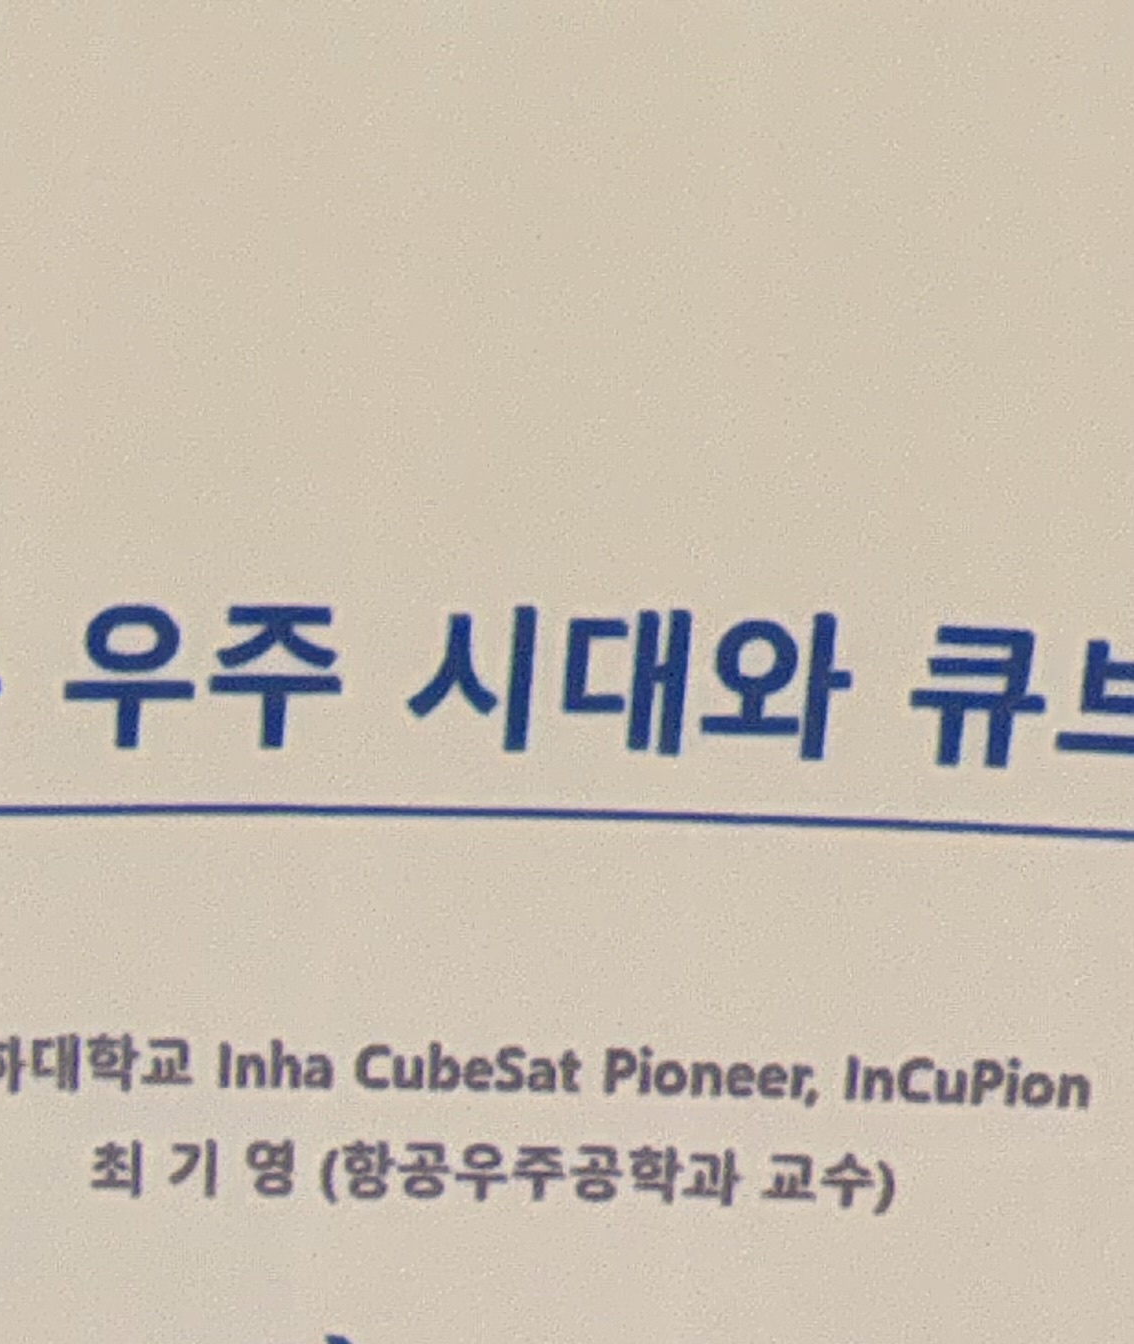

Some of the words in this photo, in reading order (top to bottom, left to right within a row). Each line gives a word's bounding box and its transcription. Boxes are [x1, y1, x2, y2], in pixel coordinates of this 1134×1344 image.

[64, 605, 342, 748] 우주
[408, 606, 852, 760] 시대와
[911, 626, 1134, 768] 큐브
[219, 1039, 334, 1089] Inha
[356, 1042, 581, 1094] CubeSat
[604, 1046, 818, 1107] Pioneer,
[845, 1055, 1090, 1108] InCuPion
[91, 1140, 142, 1197] 최
[169, 1139, 217, 1197] 기
[246, 1140, 296, 1197] 영
[321, 1140, 741, 1206] (항공우주공학과
[762, 1149, 895, 1215] 교수)
